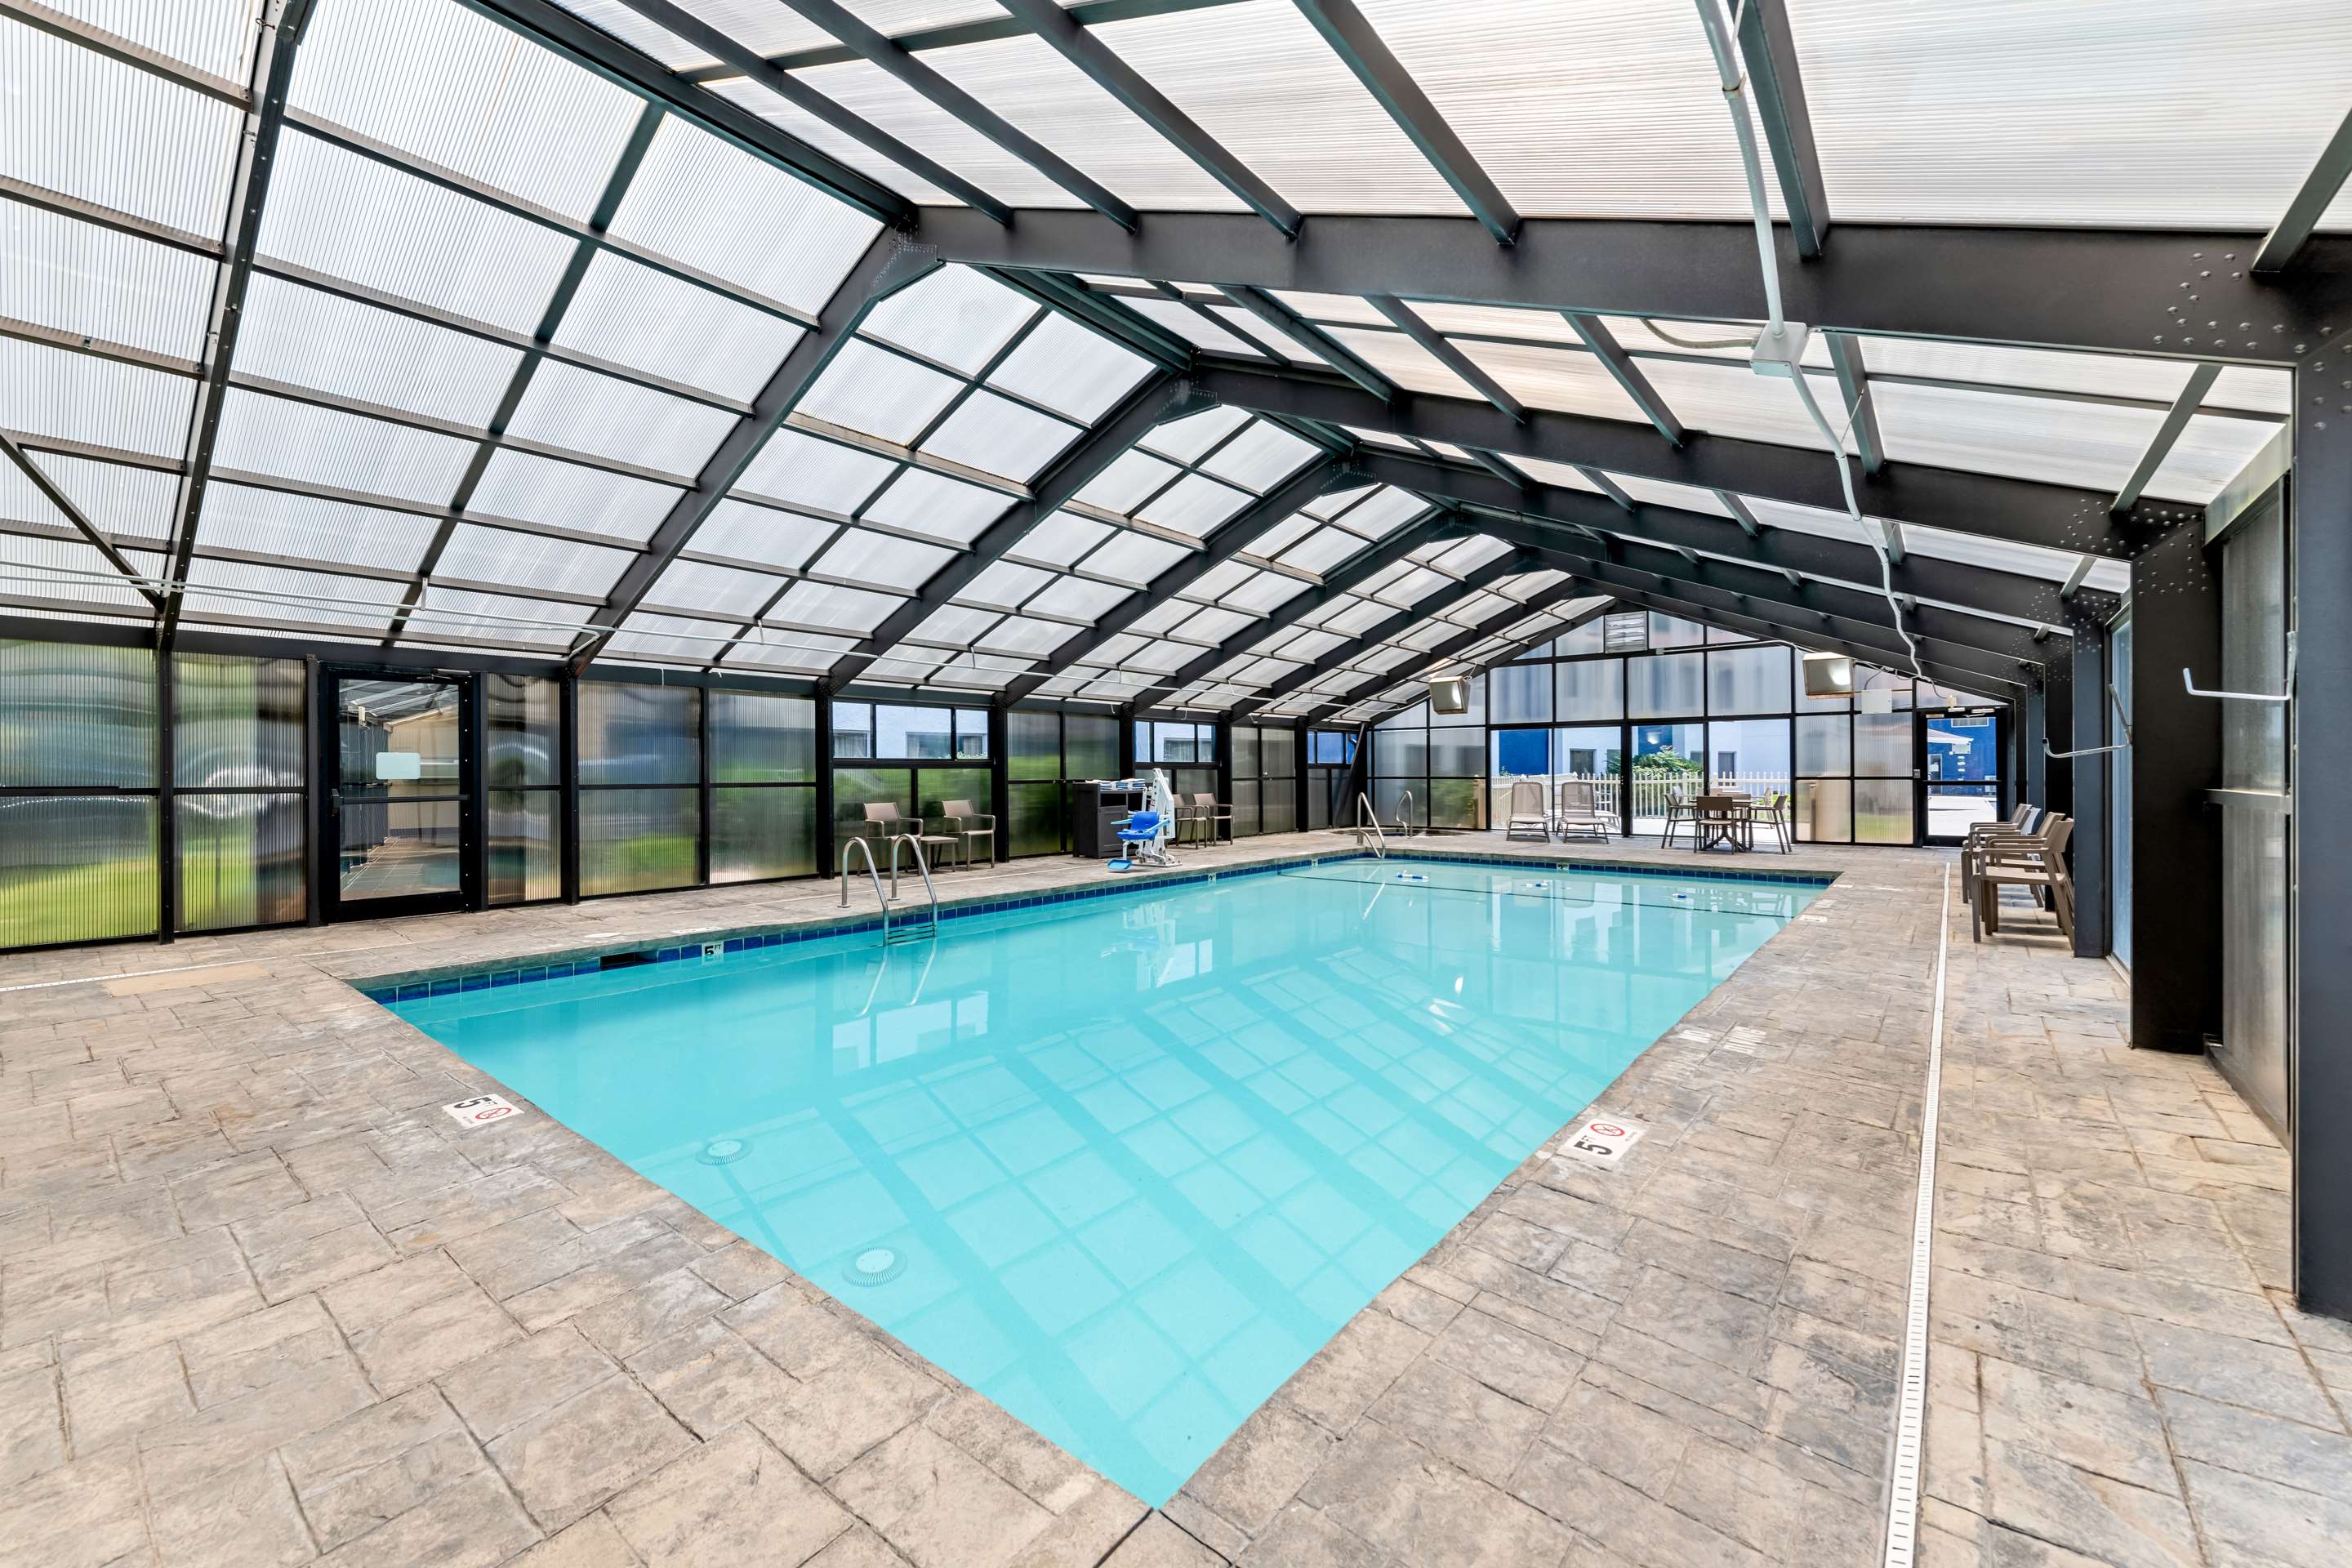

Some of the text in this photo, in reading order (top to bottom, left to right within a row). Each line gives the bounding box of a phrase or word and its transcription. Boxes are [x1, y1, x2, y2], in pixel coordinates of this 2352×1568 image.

[705, 945, 715, 955] 5
[453, 1097, 492, 1108] 5
[1574, 1141, 1613, 1155] 5
